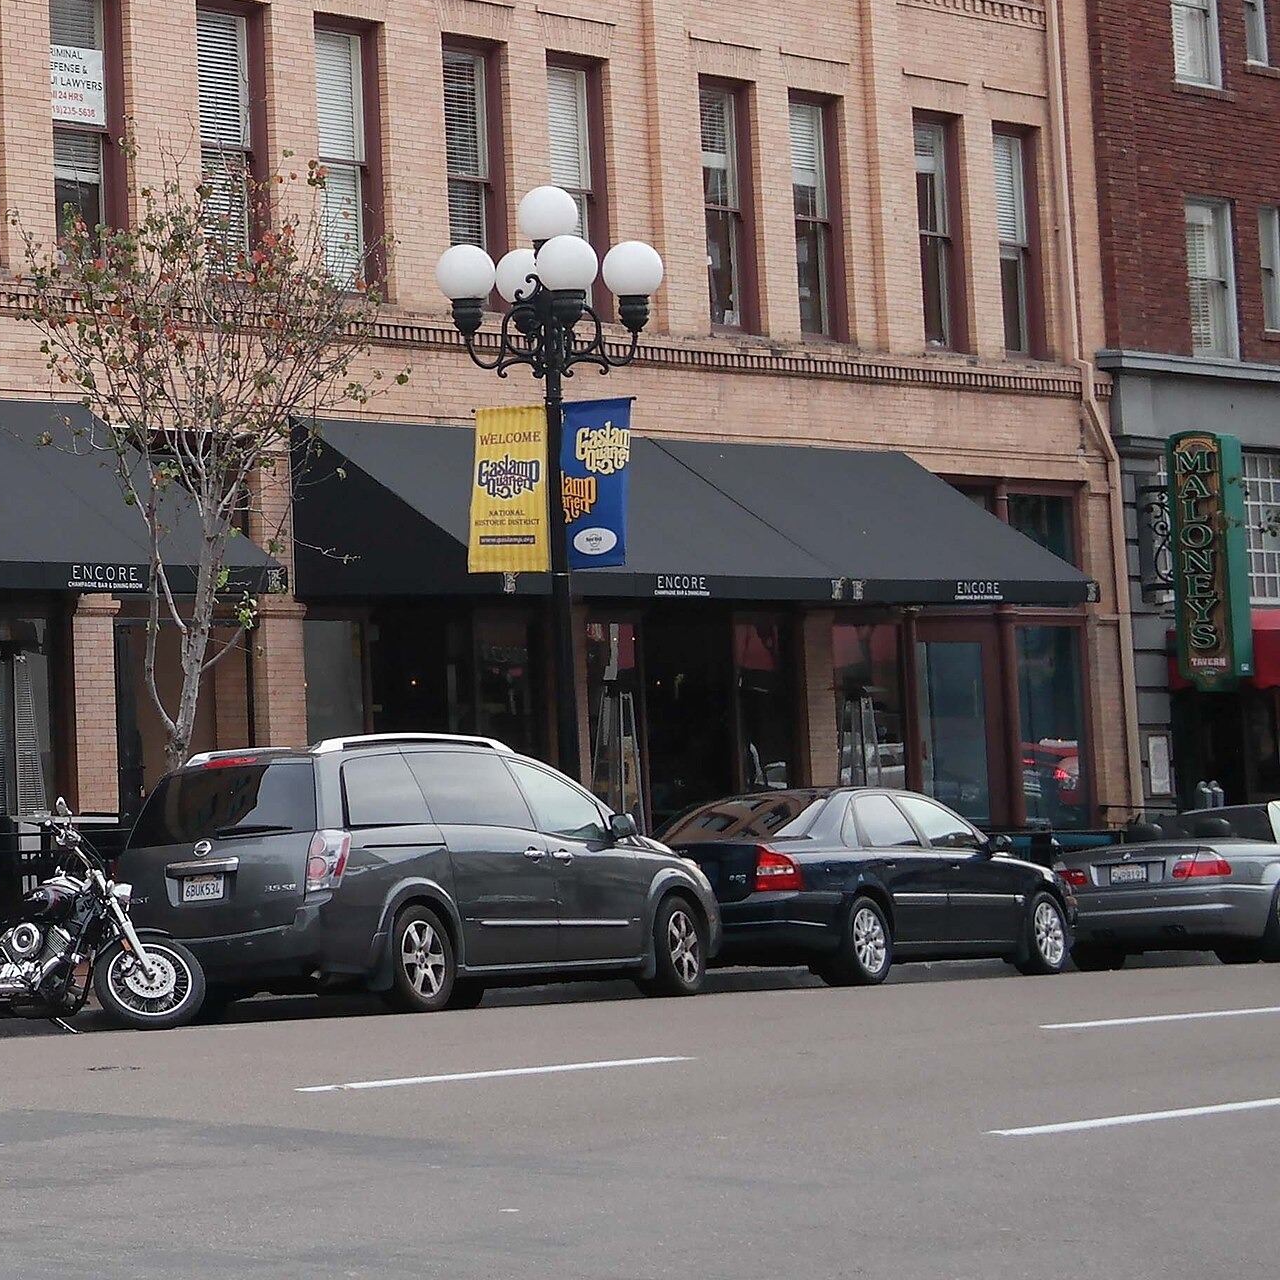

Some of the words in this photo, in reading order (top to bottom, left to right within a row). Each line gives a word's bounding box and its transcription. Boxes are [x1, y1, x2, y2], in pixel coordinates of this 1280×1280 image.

[50, 47, 83, 60] RIMINAL
[50, 61, 80, 74] EFENSE
[60, 77, 103, 91] LAWYERS
[68, 93, 84, 102] HRS
[480, 430, 542, 446] WELCOME
[575, 420, 630, 461] Gaslam
[477, 453, 541, 488] Gaslamp
[489, 509, 525, 517] NATIONAL
[72, 565, 138, 581] ENCORE
[657, 575, 707, 590] ENCORE
[957, 581, 1000, 594] ENCORE
[1190, 657, 1227, 667] TAVERN
